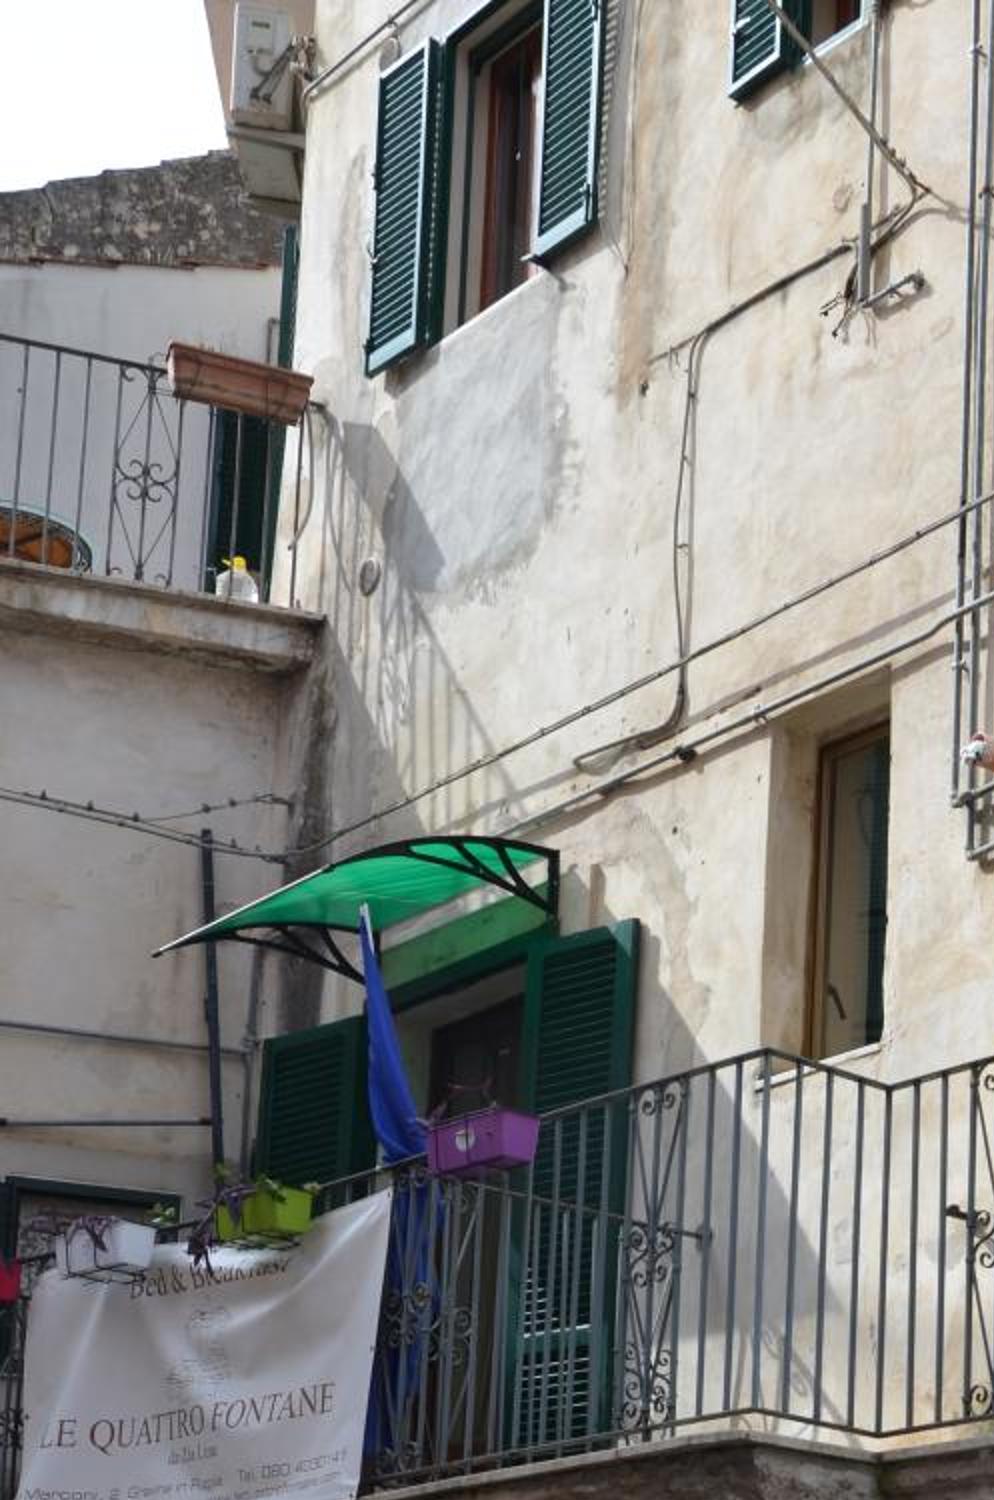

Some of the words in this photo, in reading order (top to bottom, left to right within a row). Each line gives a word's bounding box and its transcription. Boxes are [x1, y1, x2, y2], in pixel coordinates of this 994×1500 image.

[39, 1418, 78, 1449] LE
[89, 1404, 206, 1457] QUATTRO
[209, 1381, 337, 1433] FONTANE
